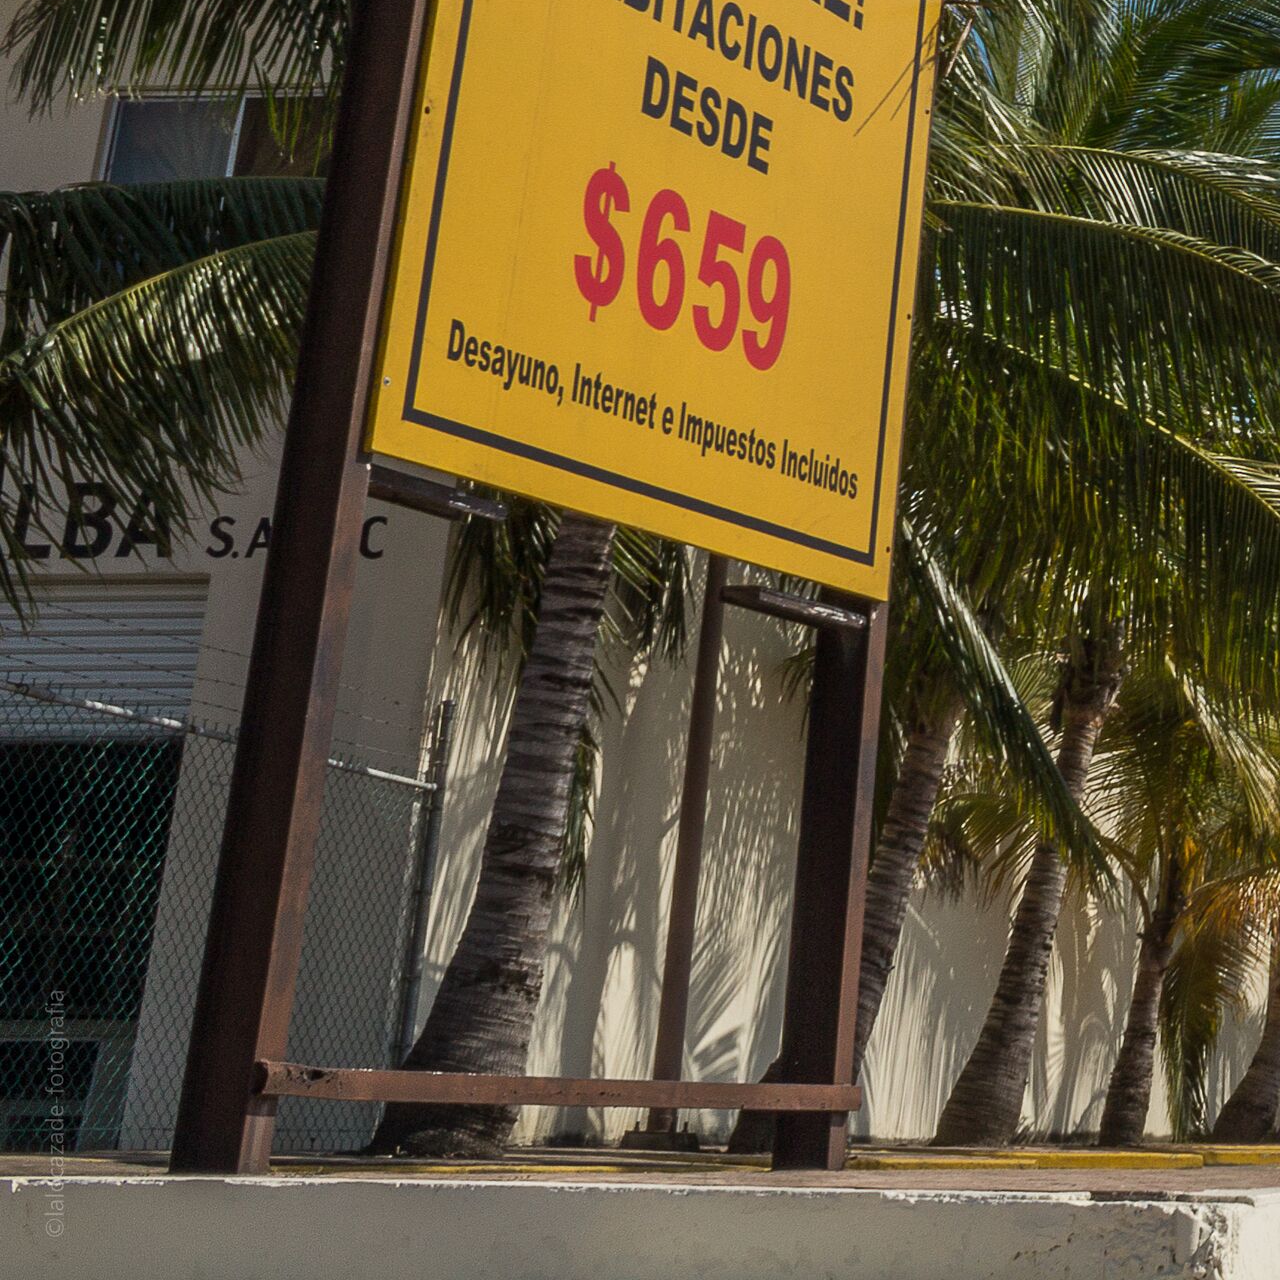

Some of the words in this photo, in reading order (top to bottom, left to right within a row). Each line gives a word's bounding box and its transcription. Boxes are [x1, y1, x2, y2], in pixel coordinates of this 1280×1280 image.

[641, 55, 773, 176] DESDE
[574, 160, 791, 371] $659
[446, 318, 565, 407] Desayuno,
[571, 362, 657, 420] Internet
[661, 406, 674, 435] e
[678, 401, 776, 470] Impuestos
[780, 438, 858, 500] Incluidos
